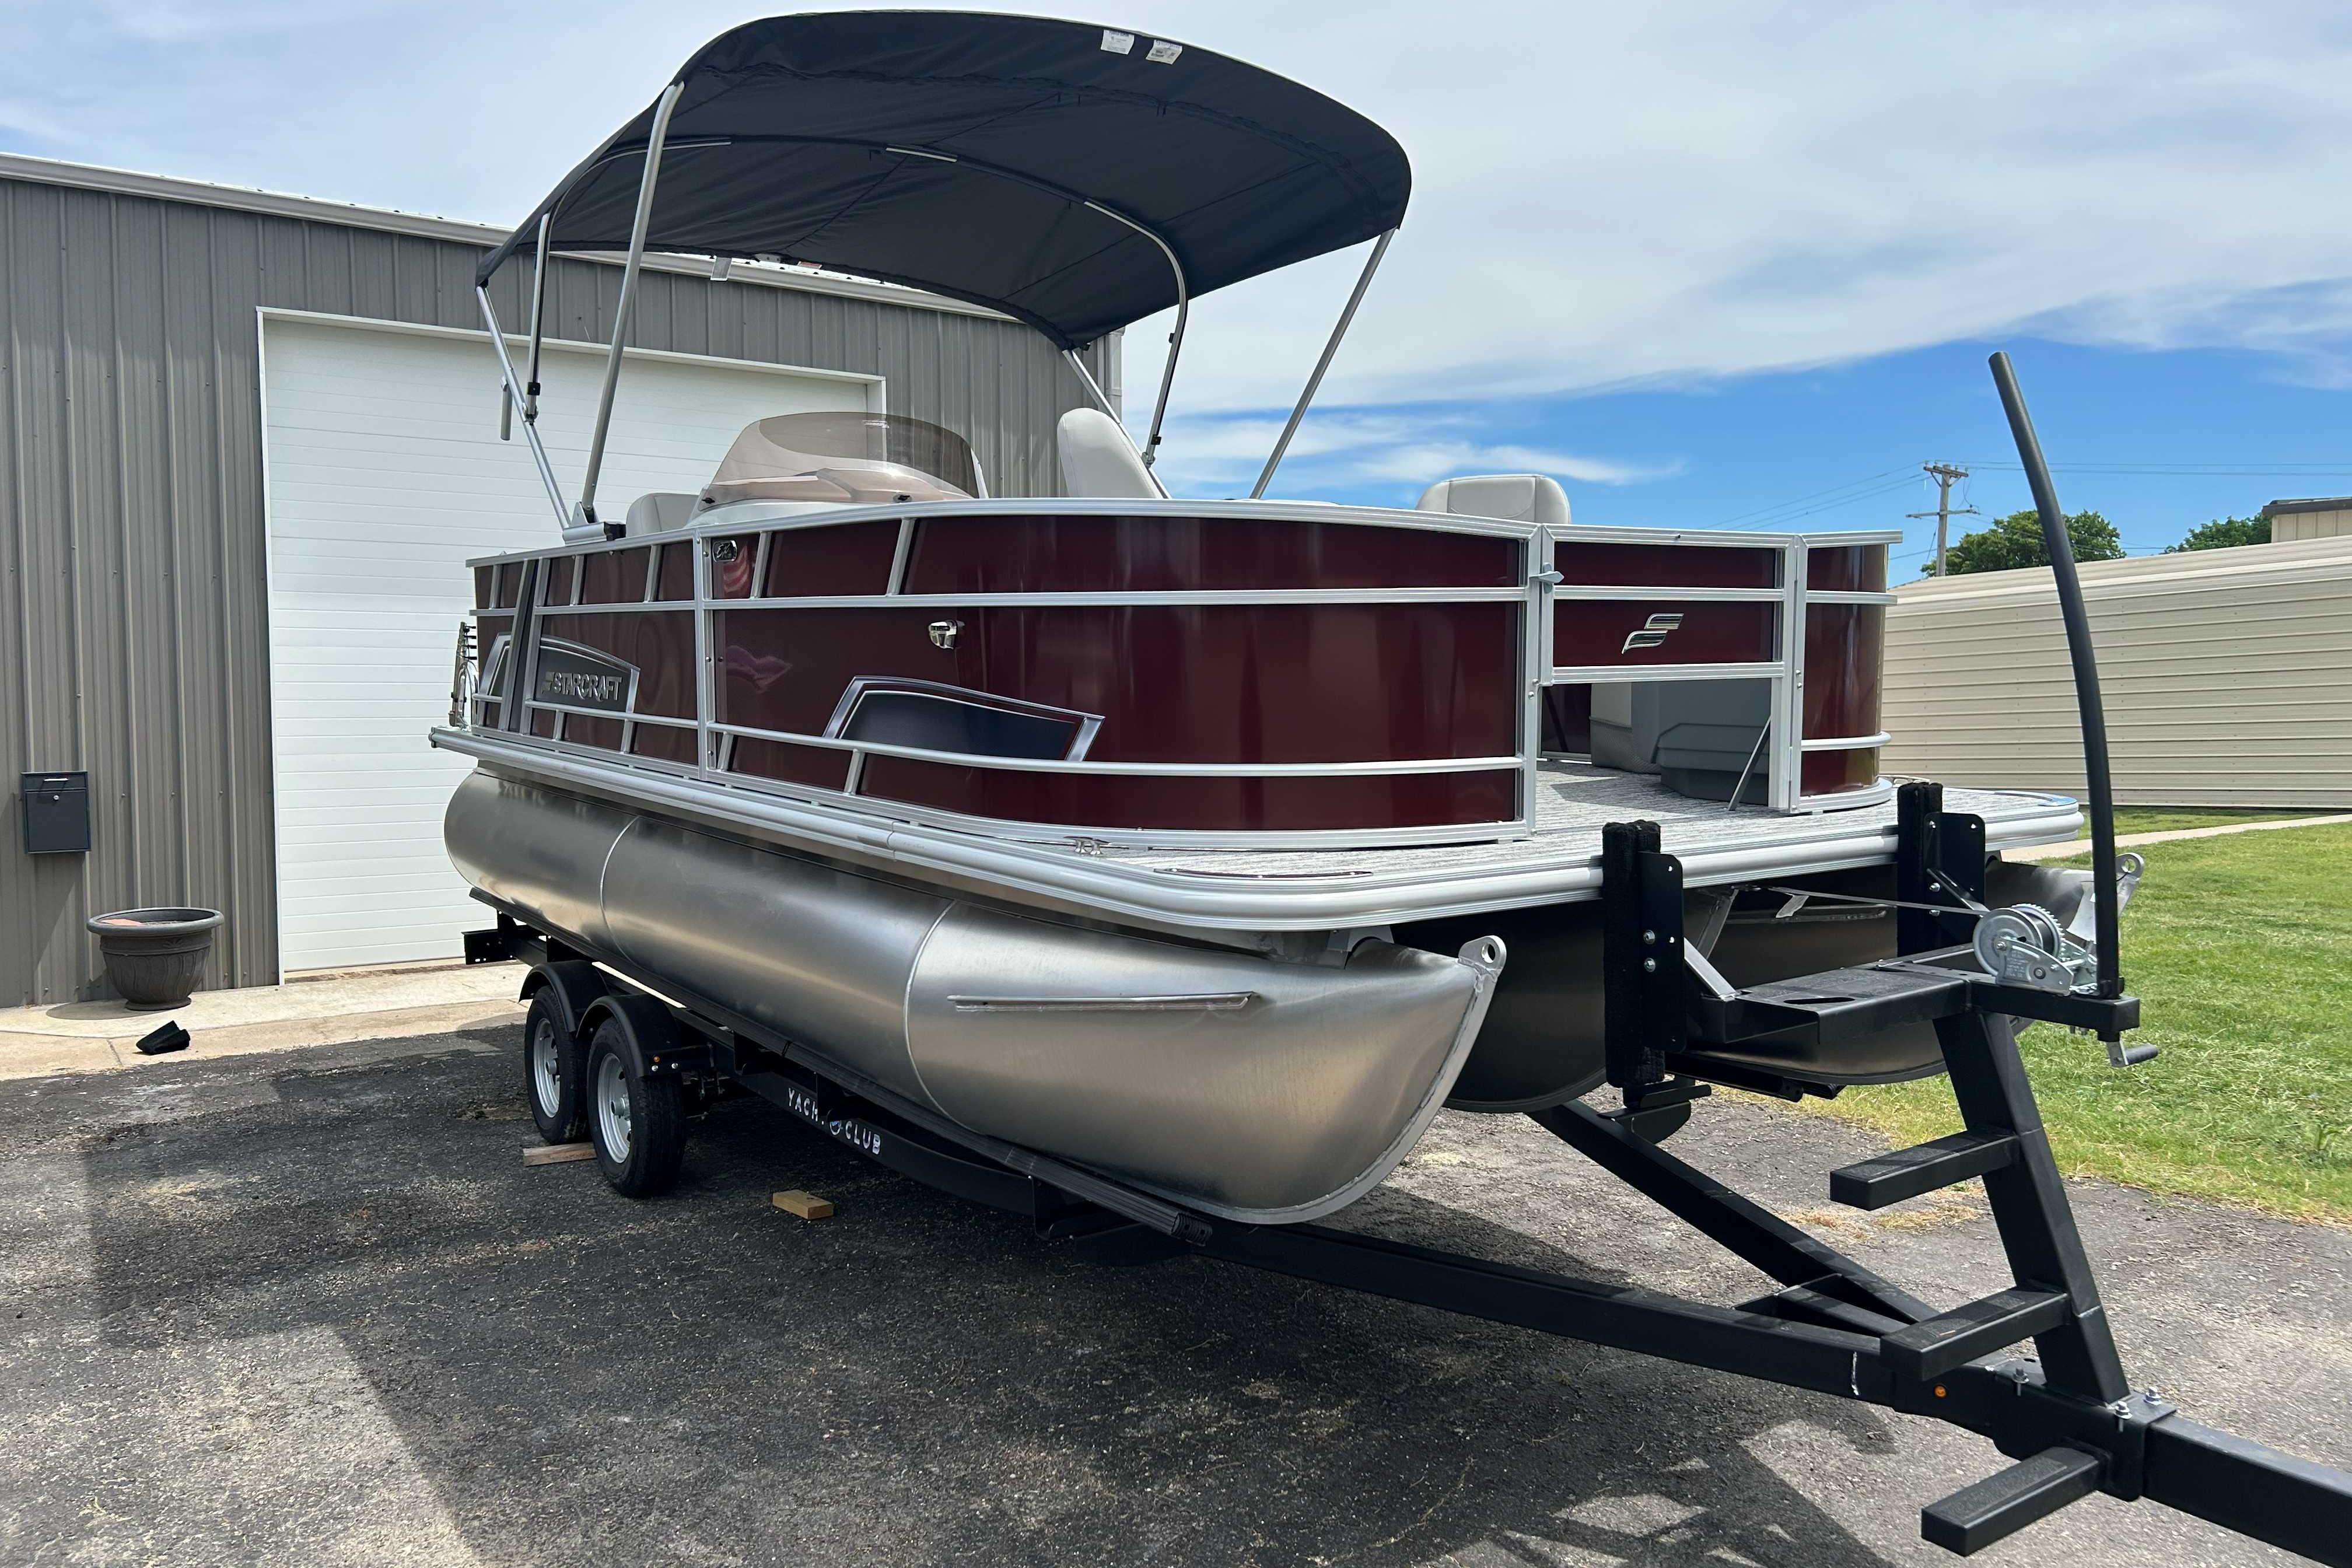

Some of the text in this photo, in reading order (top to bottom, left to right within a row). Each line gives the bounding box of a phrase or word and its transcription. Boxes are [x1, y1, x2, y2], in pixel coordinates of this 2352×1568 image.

[554, 672, 622, 702] STARCRAFT
[788, 1087, 881, 1155] YACH CLUB
